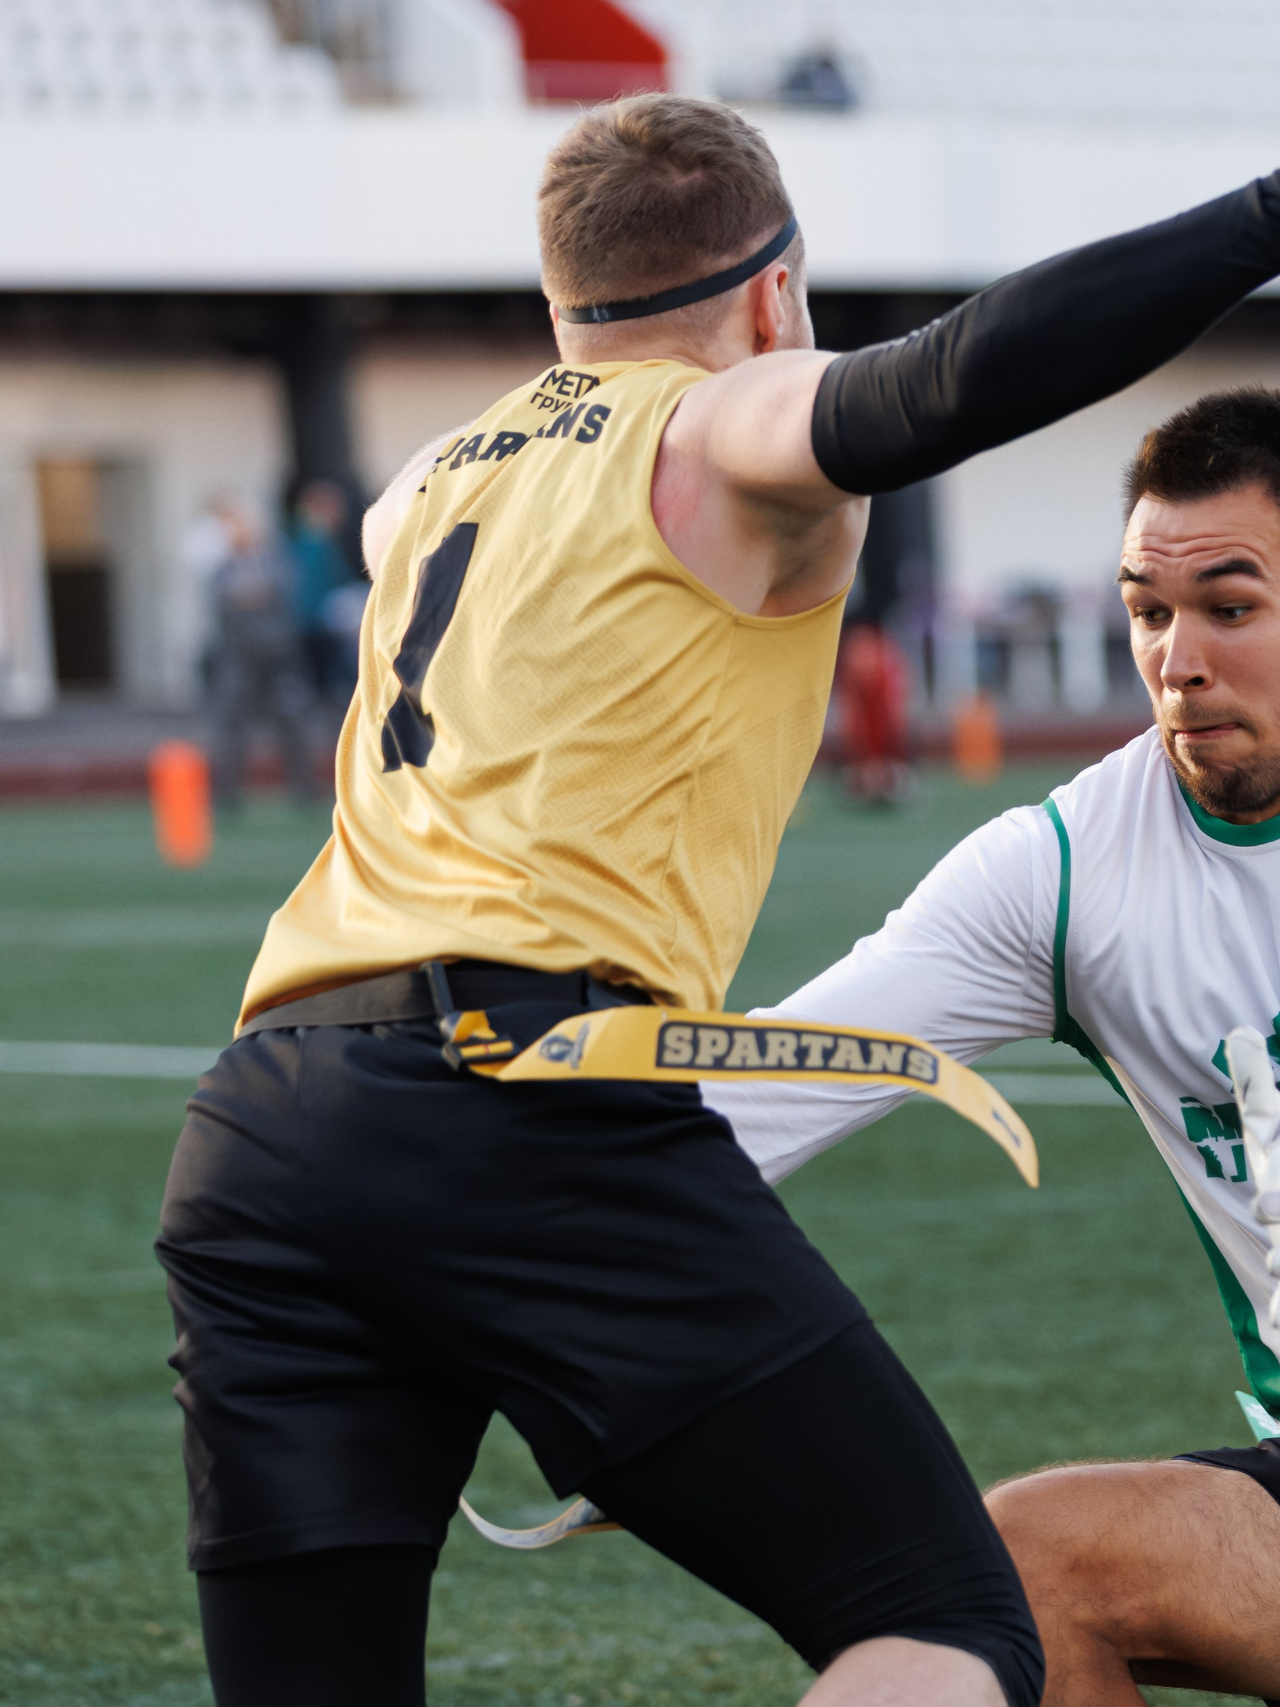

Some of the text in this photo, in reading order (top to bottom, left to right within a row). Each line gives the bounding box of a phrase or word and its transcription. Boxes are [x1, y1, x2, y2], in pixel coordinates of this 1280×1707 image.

[530, 392, 573, 413] гру
[382, 522, 479, 773] 1
[662, 1025, 935, 1082] SPARTANS
